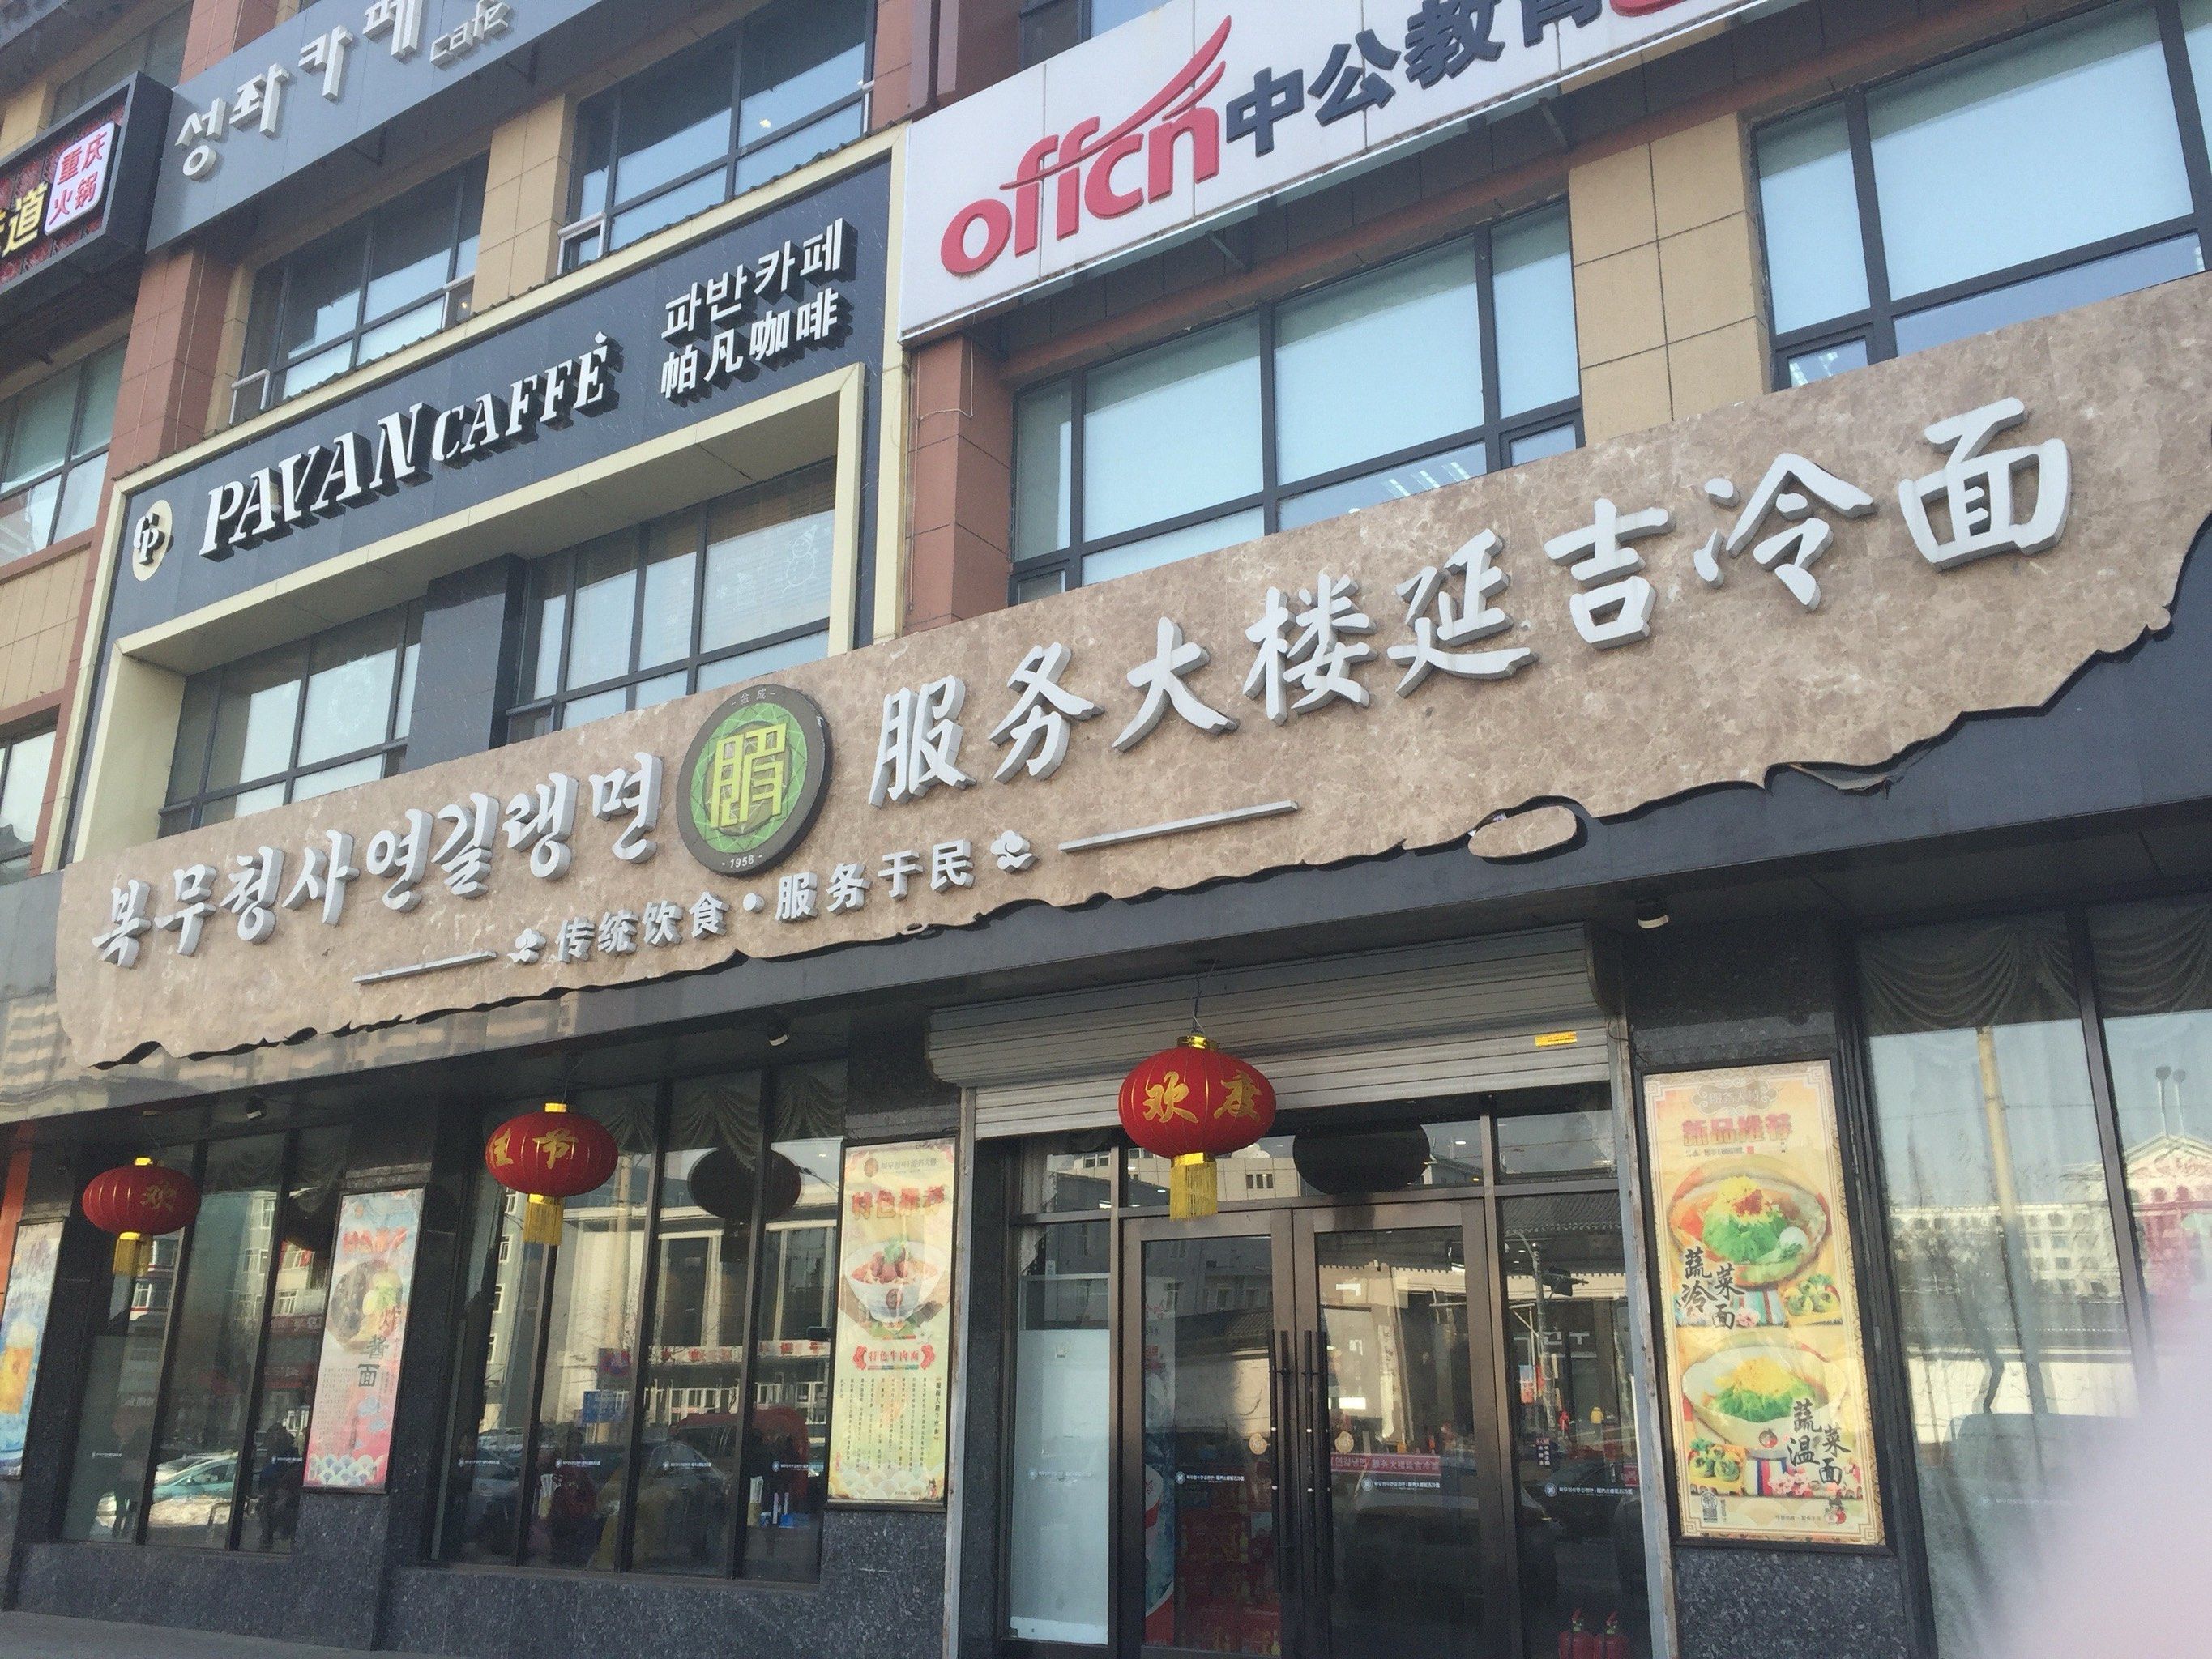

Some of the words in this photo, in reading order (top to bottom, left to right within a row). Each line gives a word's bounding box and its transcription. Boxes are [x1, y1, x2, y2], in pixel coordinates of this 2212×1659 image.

[58, 131, 107, 186] 重庆
[940, 61, 1223, 276] offcn
[0, 181, 49, 258] 道
[49, 171, 98, 225] 火锅
[661, 218, 844, 339] 파반카페
[660, 288, 839, 398] 帕凡咖啡
[200, 403, 422, 556] PAVAN
[868, 397, 2073, 808] 服务大楼延吉冷面
[730, 855, 754, 868] 1958
[1143, 1069, 1262, 1124] 欢度
[490, 1128, 579, 1170] 佳节
